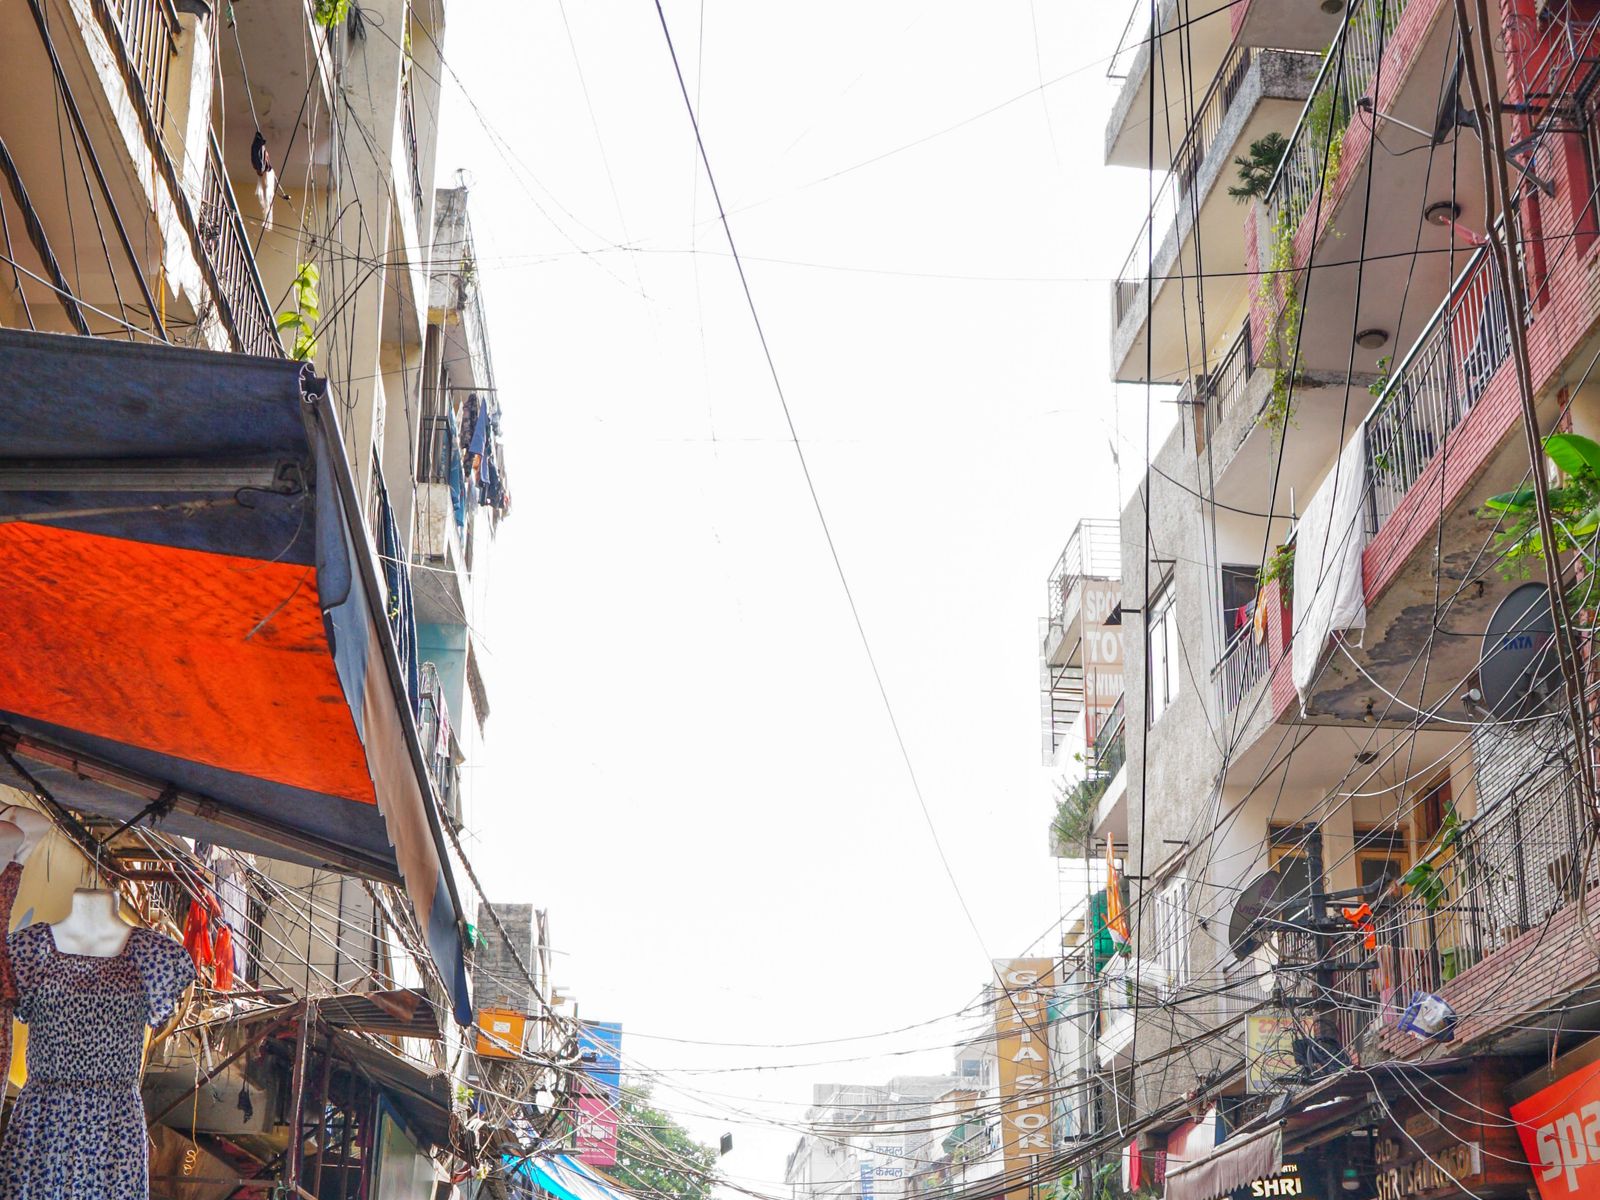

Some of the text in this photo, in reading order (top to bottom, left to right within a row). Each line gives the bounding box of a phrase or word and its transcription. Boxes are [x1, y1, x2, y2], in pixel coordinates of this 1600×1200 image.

[1086, 590, 1121, 622] SPO
[1503, 636, 1532, 651] TATA
[1253, 1177, 1302, 1198] SHRI
